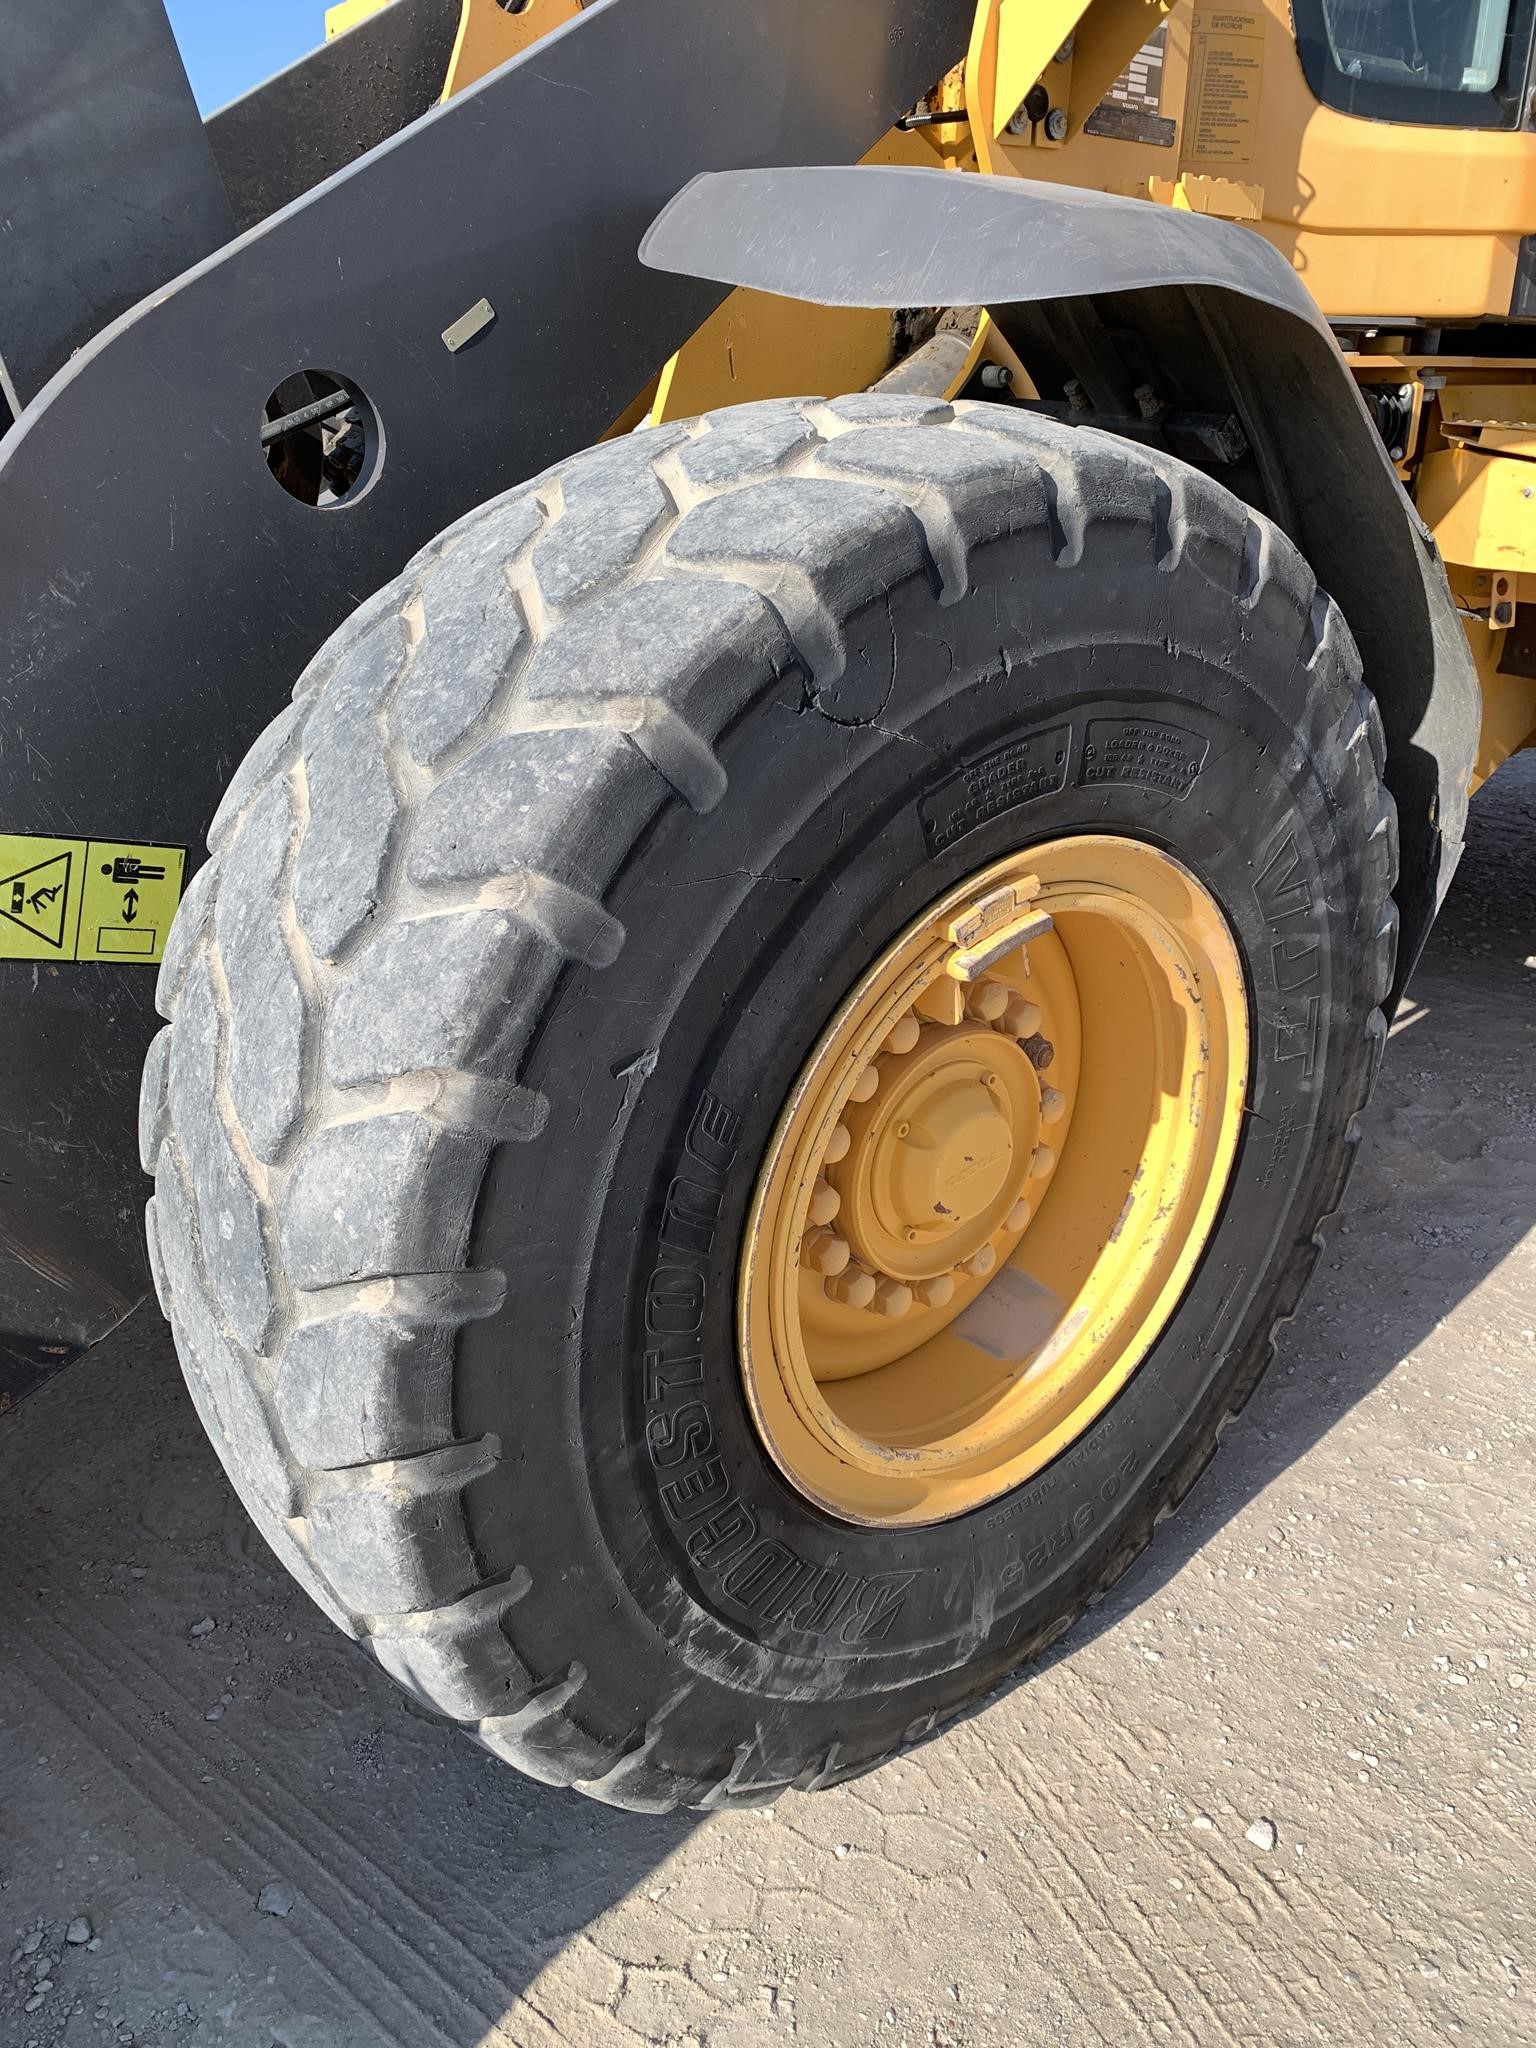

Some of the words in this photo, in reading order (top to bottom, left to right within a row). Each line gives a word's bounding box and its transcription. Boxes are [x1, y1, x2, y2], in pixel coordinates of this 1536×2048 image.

[1220, 22, 1242, 30] FILTROS
[1122, 102, 1138, 110] VOLVO
[1105, 739, 1145, 750] LOADER
[968, 758, 1025, 796] GRADER
[1086, 765, 1114, 778] CUT
[1121, 766, 1186, 791] RESISTANT
[976, 774, 1057, 820] RESISTANT
[643, 1088, 925, 1645] BRIDGESTONE
[985, 1476, 1058, 1529] TUBELESS
